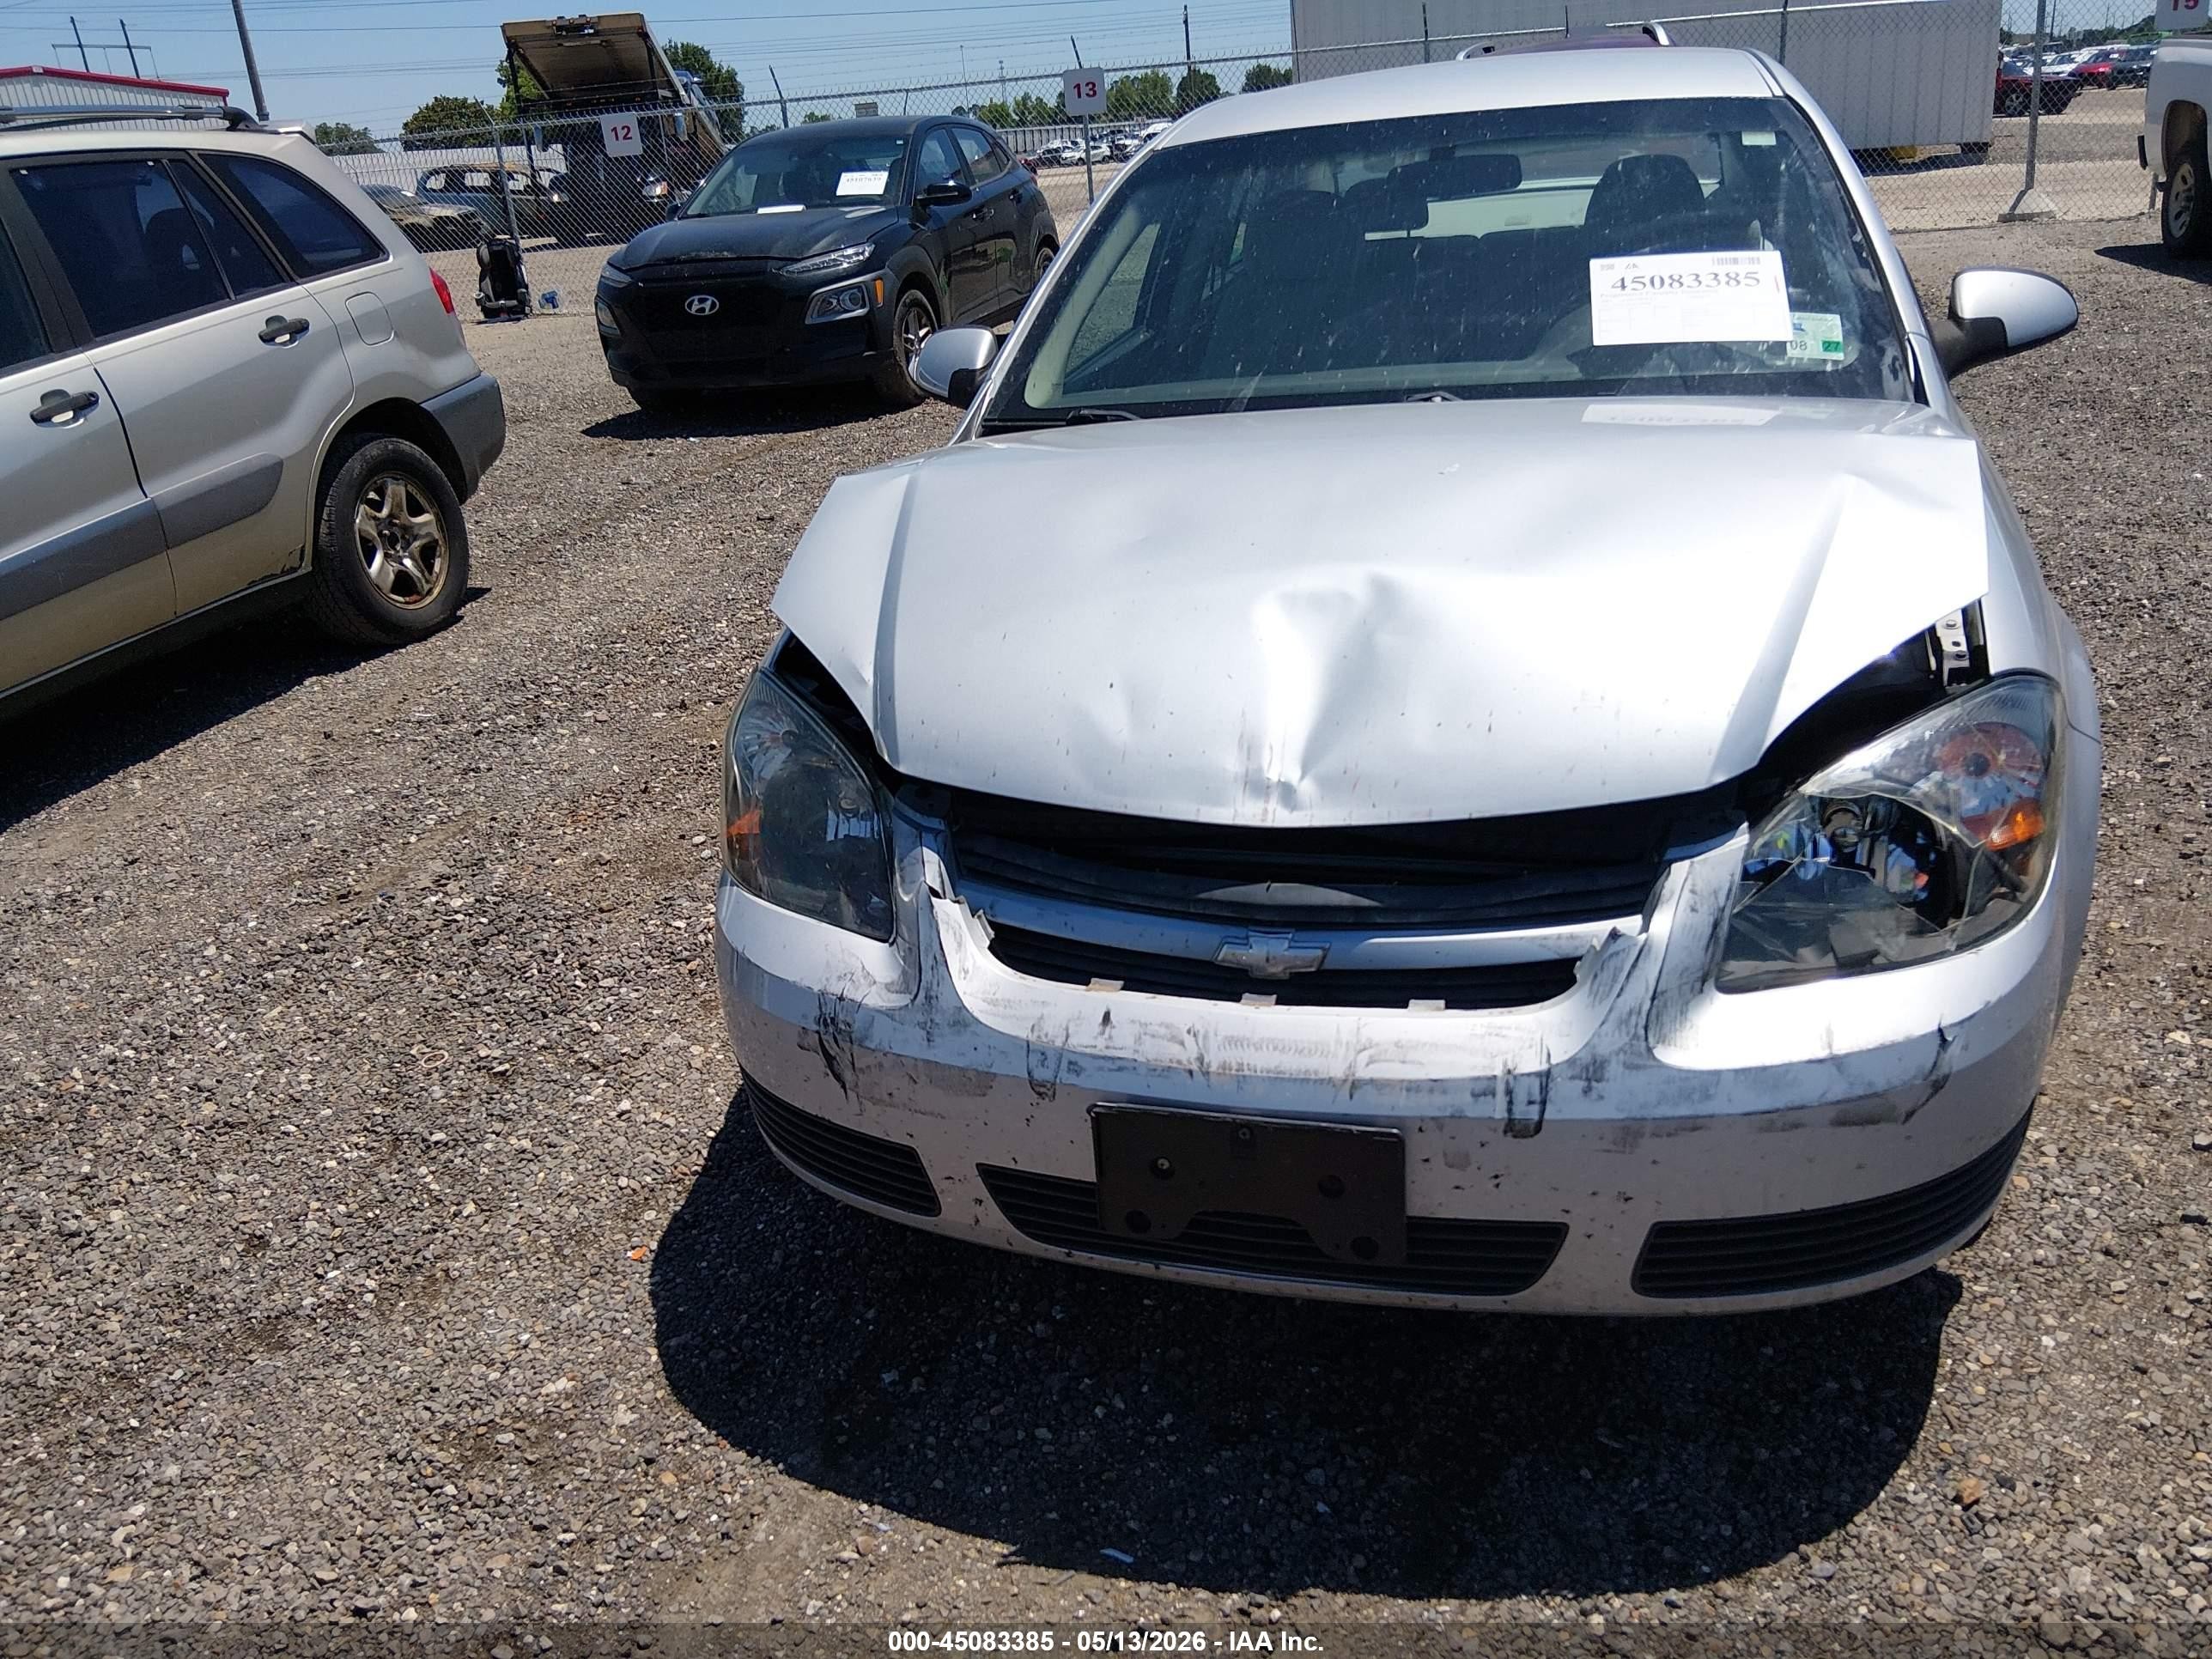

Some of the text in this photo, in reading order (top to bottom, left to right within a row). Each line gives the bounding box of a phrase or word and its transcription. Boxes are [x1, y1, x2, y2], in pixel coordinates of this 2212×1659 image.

[1073, 82, 1097, 99] 13
[611, 125, 633, 142] 12
[1610, 270, 1760, 292] 45083385
[1822, 341, 1840, 352] 27
